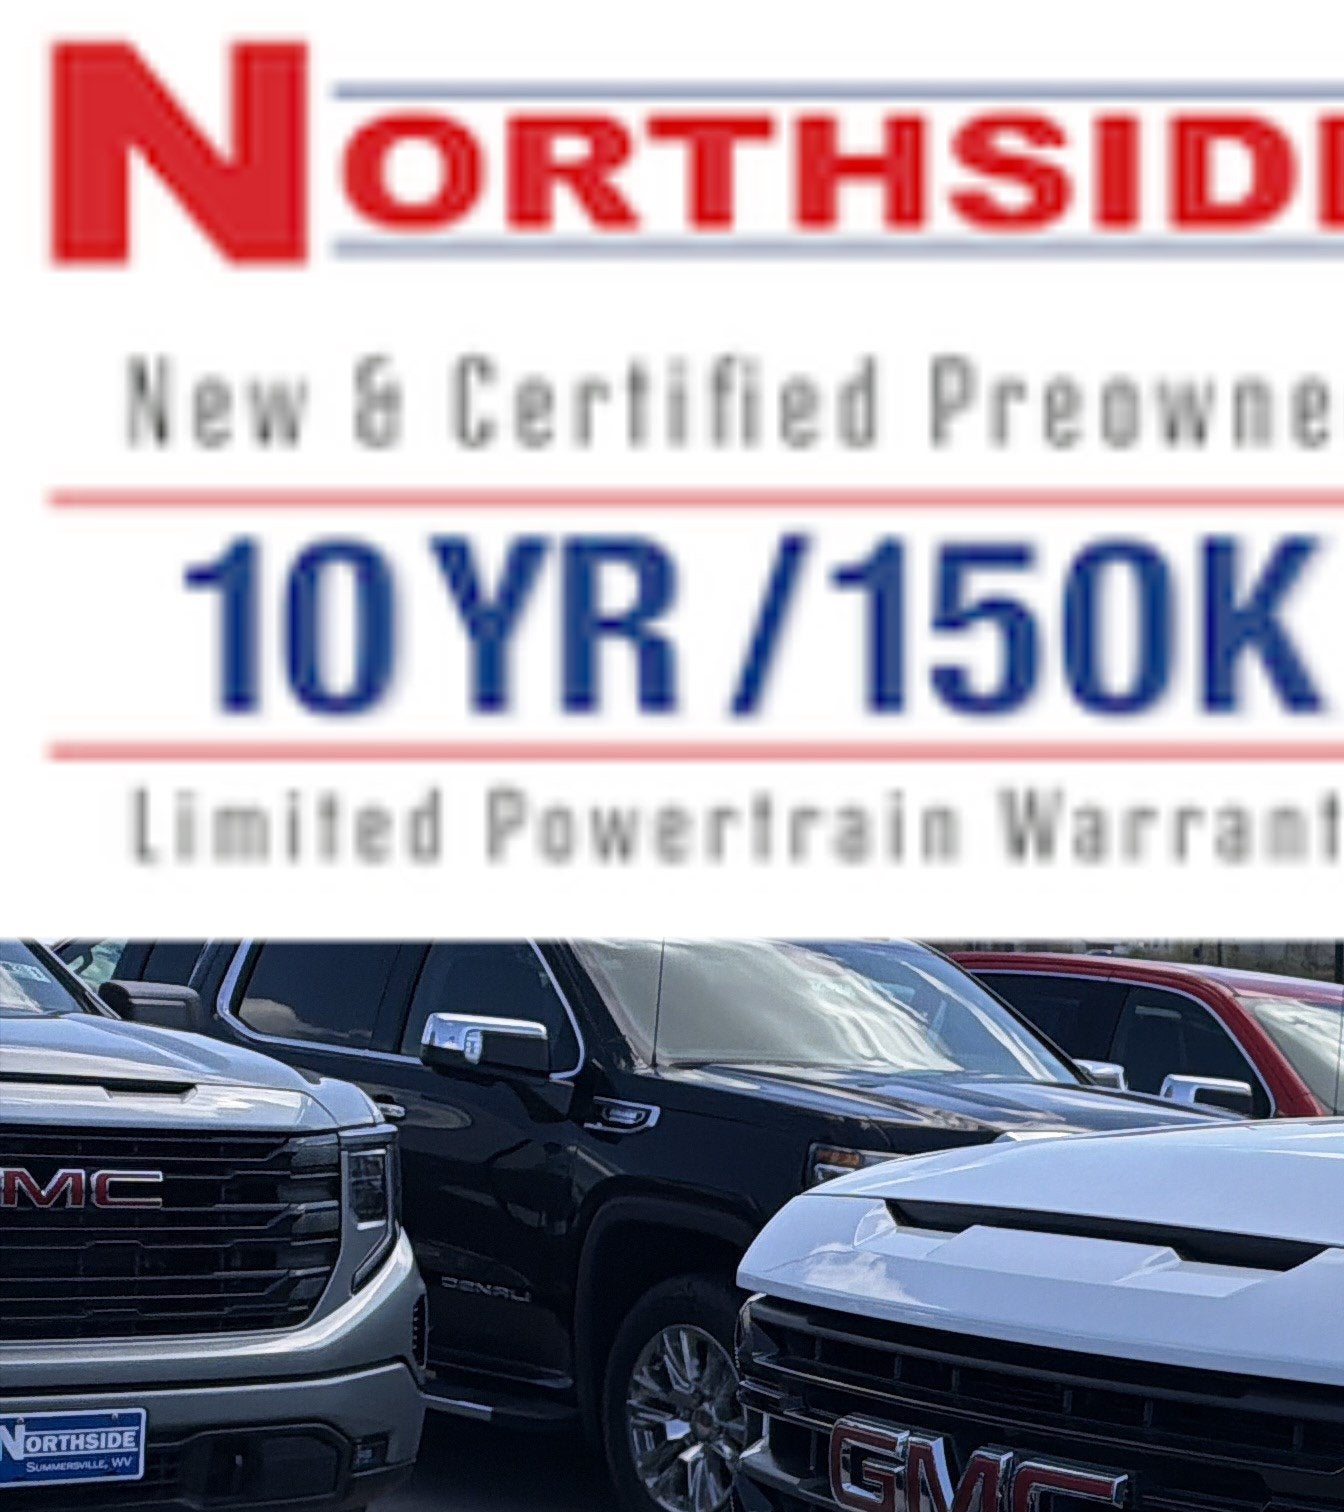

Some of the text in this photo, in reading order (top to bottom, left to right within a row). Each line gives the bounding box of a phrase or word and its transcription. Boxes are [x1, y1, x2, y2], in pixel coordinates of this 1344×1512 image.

[0, 1167, 163, 1208] MC
[0, 1423, 137, 1461] NORTHSIDE
[26, 1456, 133, 1473] SUMMERSVILLE, WV
